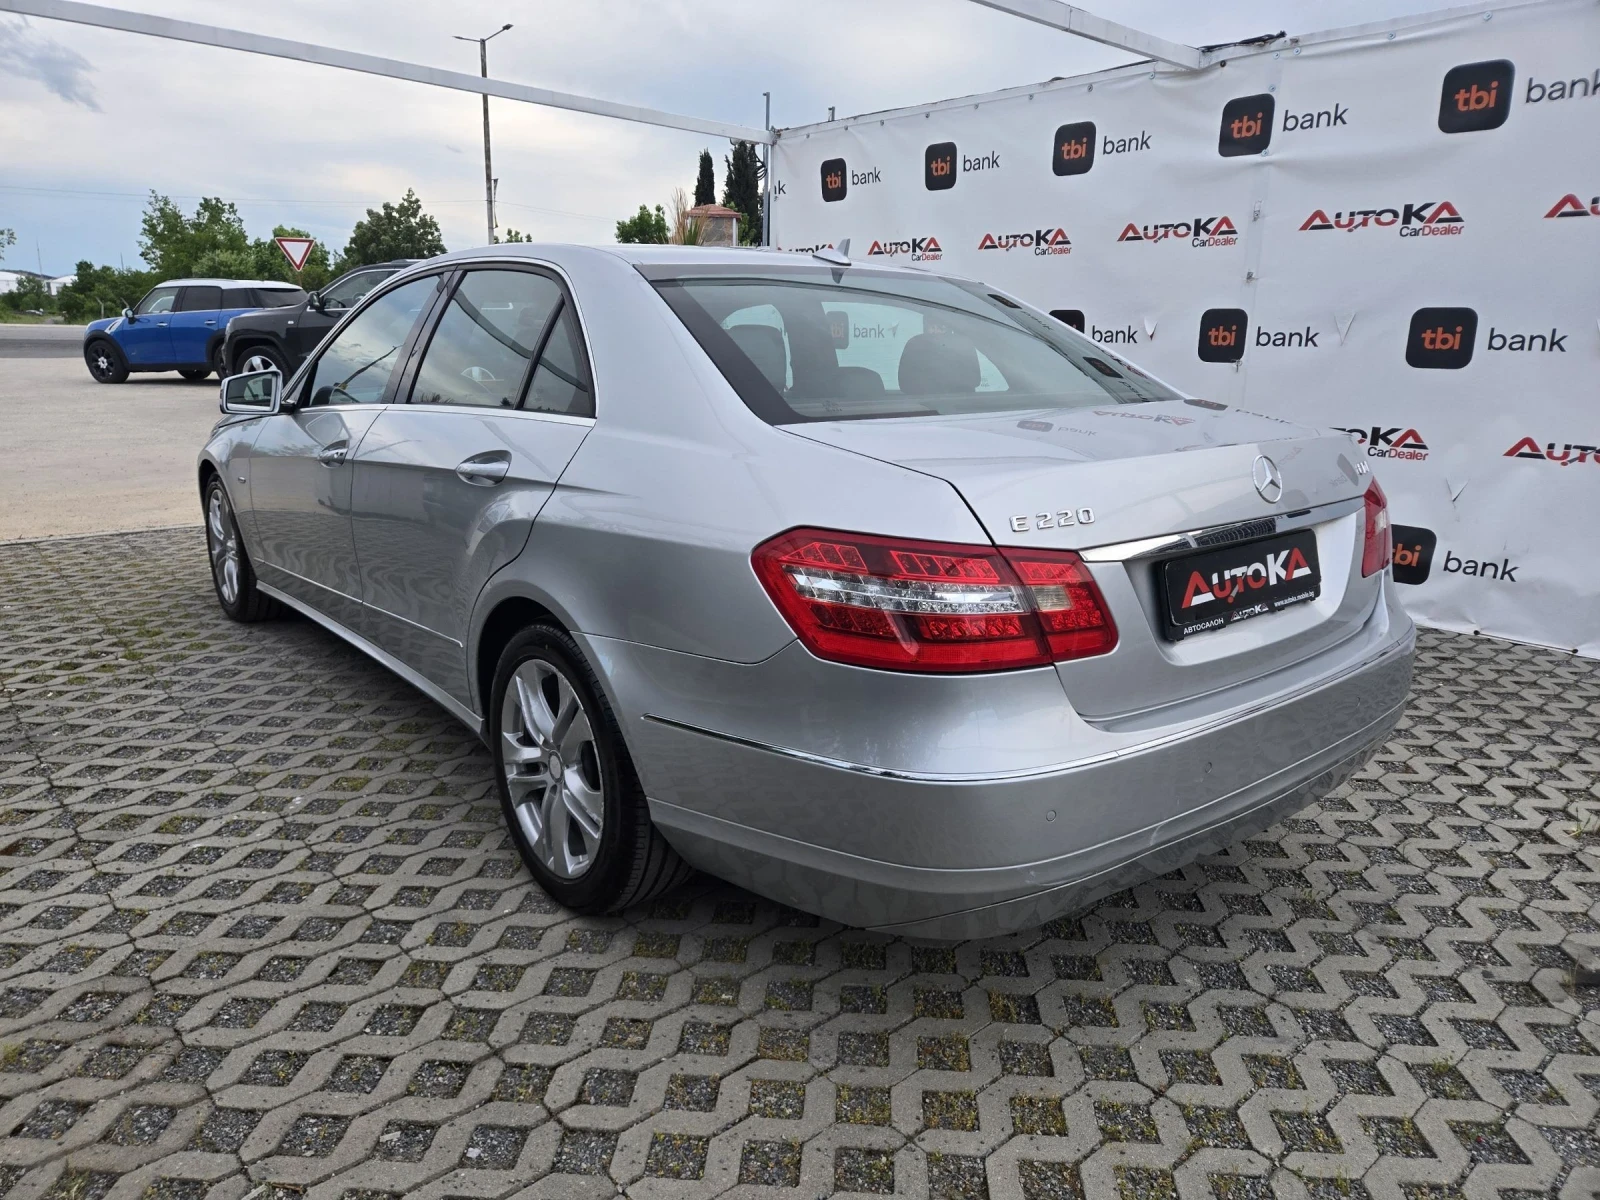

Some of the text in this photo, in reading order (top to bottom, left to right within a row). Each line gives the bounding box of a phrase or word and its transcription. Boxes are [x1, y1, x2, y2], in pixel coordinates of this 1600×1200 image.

[1454, 81, 1499, 112] tbi
[1231, 103, 1349, 139] tbi bank
[1061, 131, 1152, 160] tbi bank
[931, 151, 1000, 176] tbi bank
[826, 167, 881, 189] tbi bank
[1399, 223, 1465, 237] CarDealer
[1034, 246, 1072, 256] CarDealer
[1191, 236, 1238, 248] CarDealer
[853, 324, 885, 338] bank
[1091, 325, 1138, 344] bank
[1208, 325, 1320, 347] tbi bank
[1421, 326, 1569, 353] tbi bank
[1367, 446, 1429, 461] CarDealer
[1009, 507, 1095, 532] E 220
[1443, 550, 1520, 582] bank
[1183, 617, 1224, 634] АВТОСАЛОН
